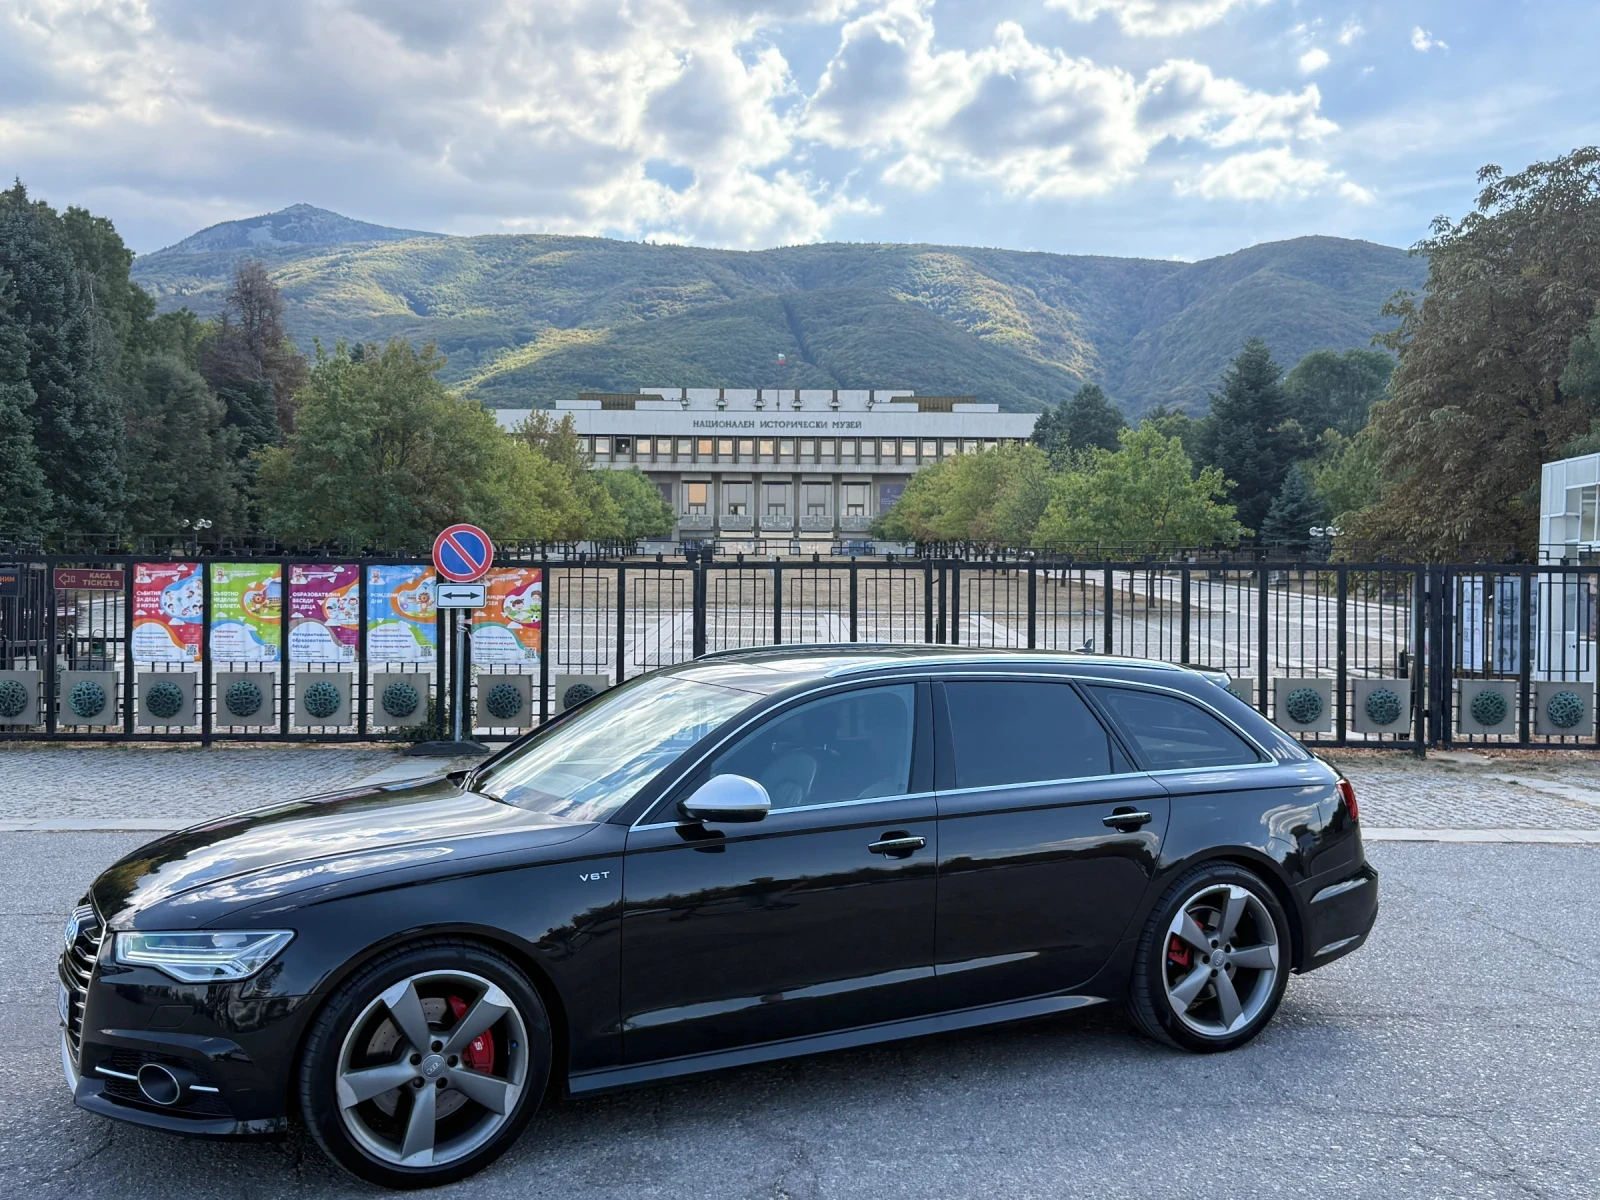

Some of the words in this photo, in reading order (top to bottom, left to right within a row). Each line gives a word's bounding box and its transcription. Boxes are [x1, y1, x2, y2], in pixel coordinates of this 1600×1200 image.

[692, 420, 755, 428] НАЦИОНАЛЕН
[759, 420, 828, 429] ИСТОРИЧЕСКИ
[832, 420, 862, 429] МУЗЕЙ
[82, 579, 120, 587] TICKETS
[579, 871, 610, 882] V6T
